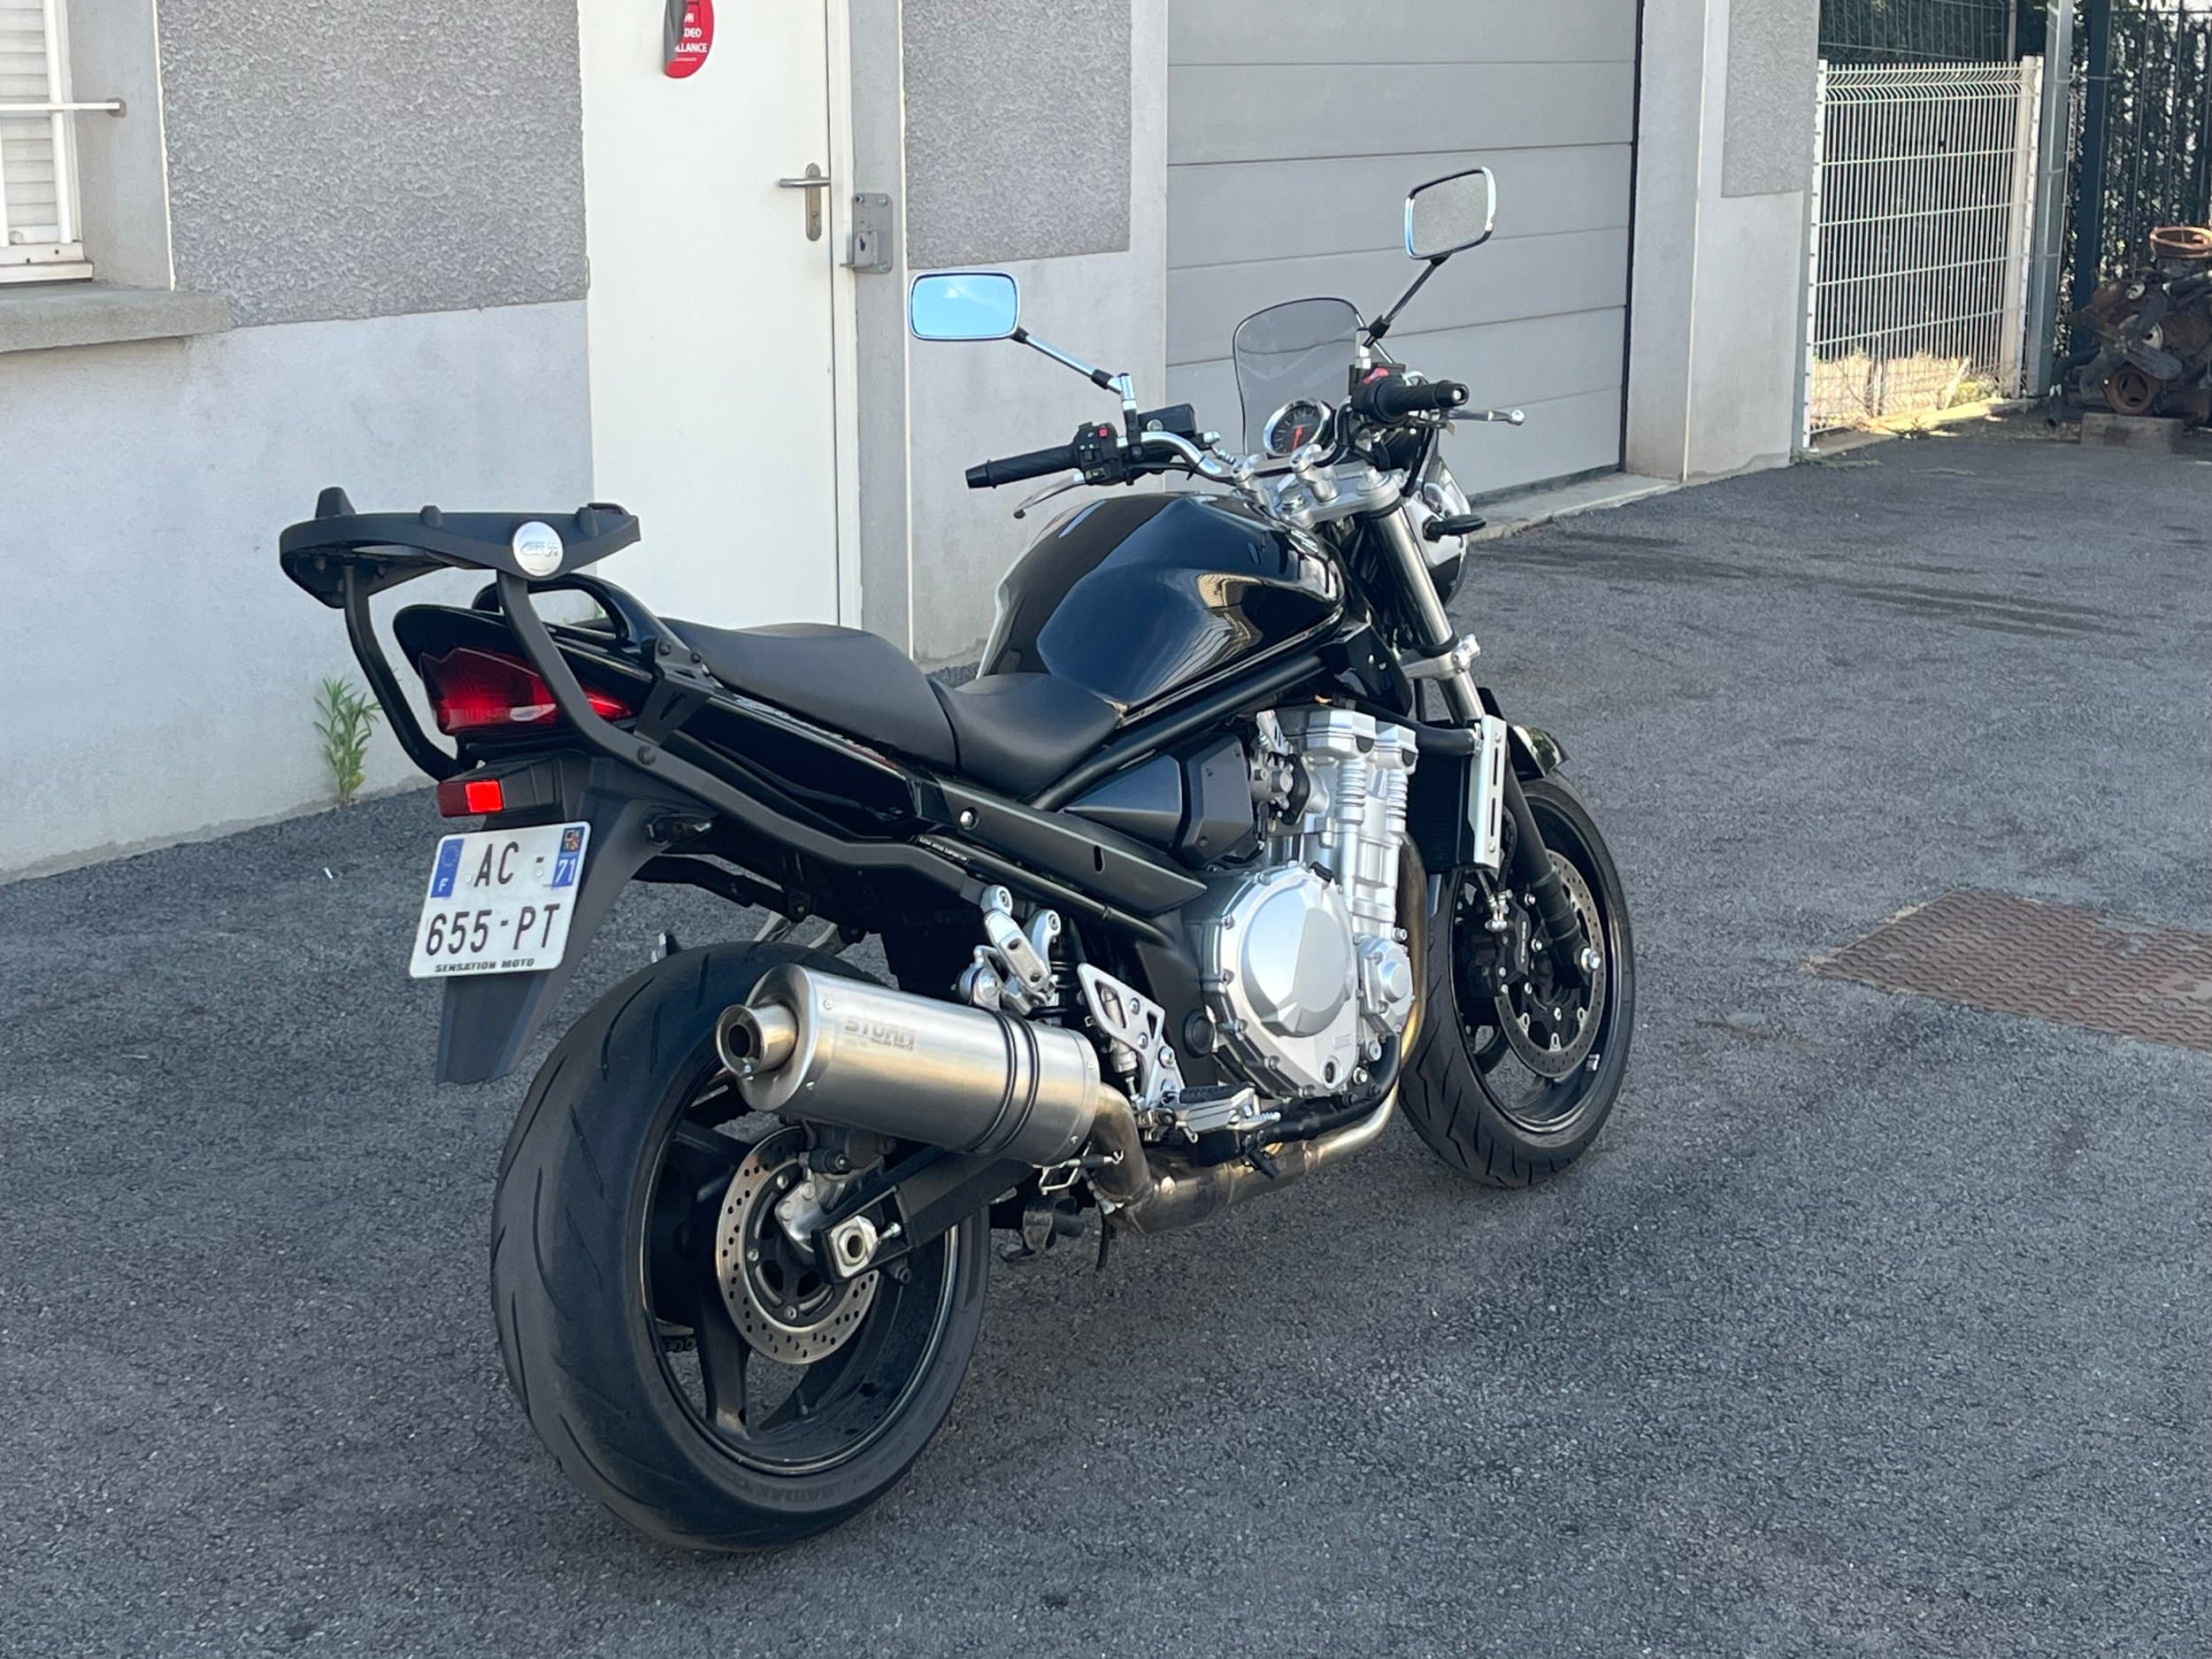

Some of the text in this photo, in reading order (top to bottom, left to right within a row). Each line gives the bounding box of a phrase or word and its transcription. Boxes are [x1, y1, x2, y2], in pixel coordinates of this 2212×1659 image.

[555, 858, 576, 884] 71
[438, 878, 449, 892] F
[434, 957, 535, 973] SENSATION MOTO
